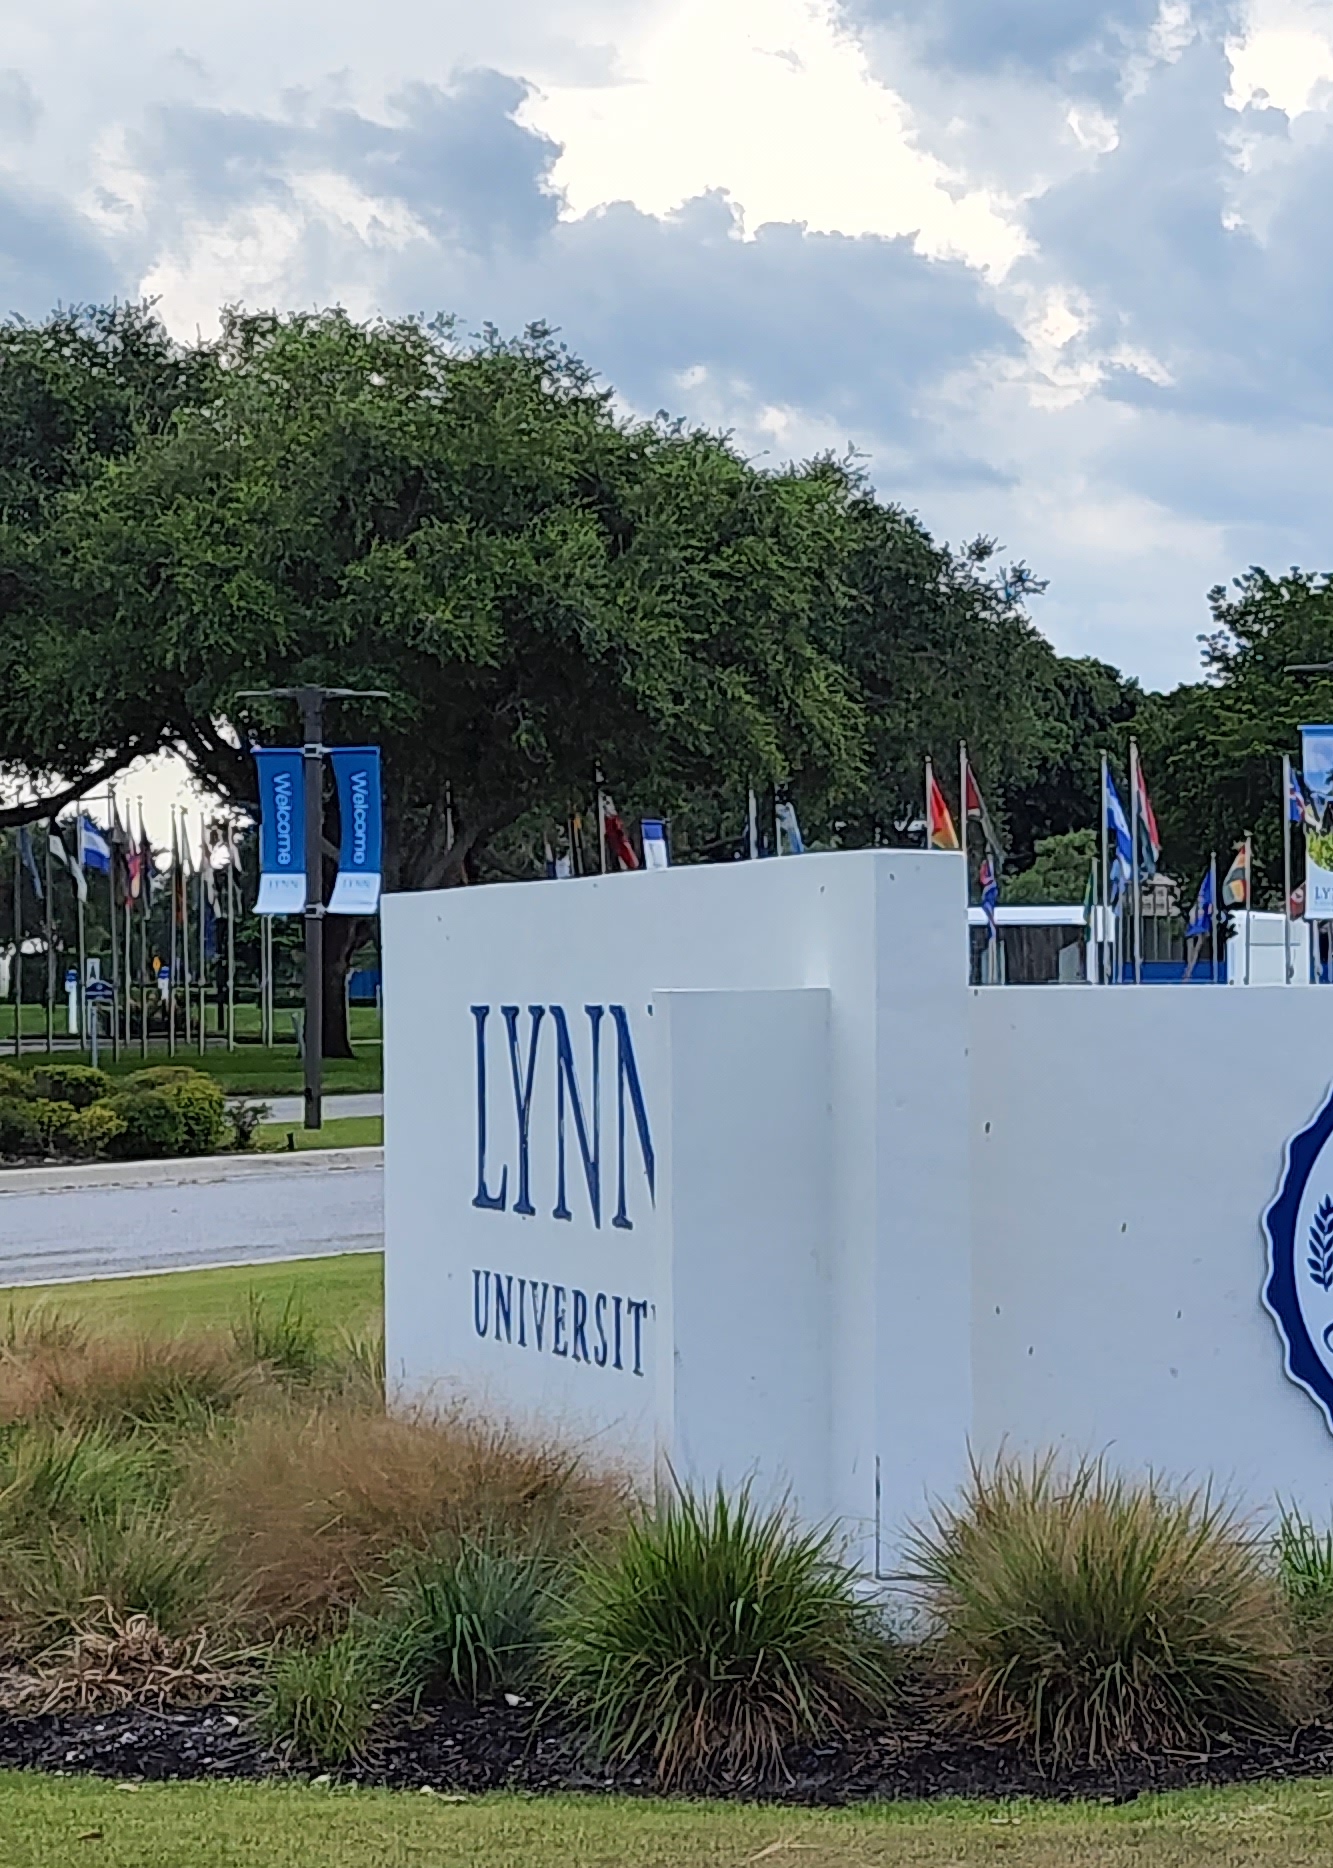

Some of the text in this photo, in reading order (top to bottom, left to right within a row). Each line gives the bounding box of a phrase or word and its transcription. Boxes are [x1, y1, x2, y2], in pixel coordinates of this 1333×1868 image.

[273, 772, 293, 865] Welcome
[351, 771, 369, 864] Welcome
[470, 1004, 656, 1230] LYNN
[471, 1269, 656, 1377] UNIVERSIT
